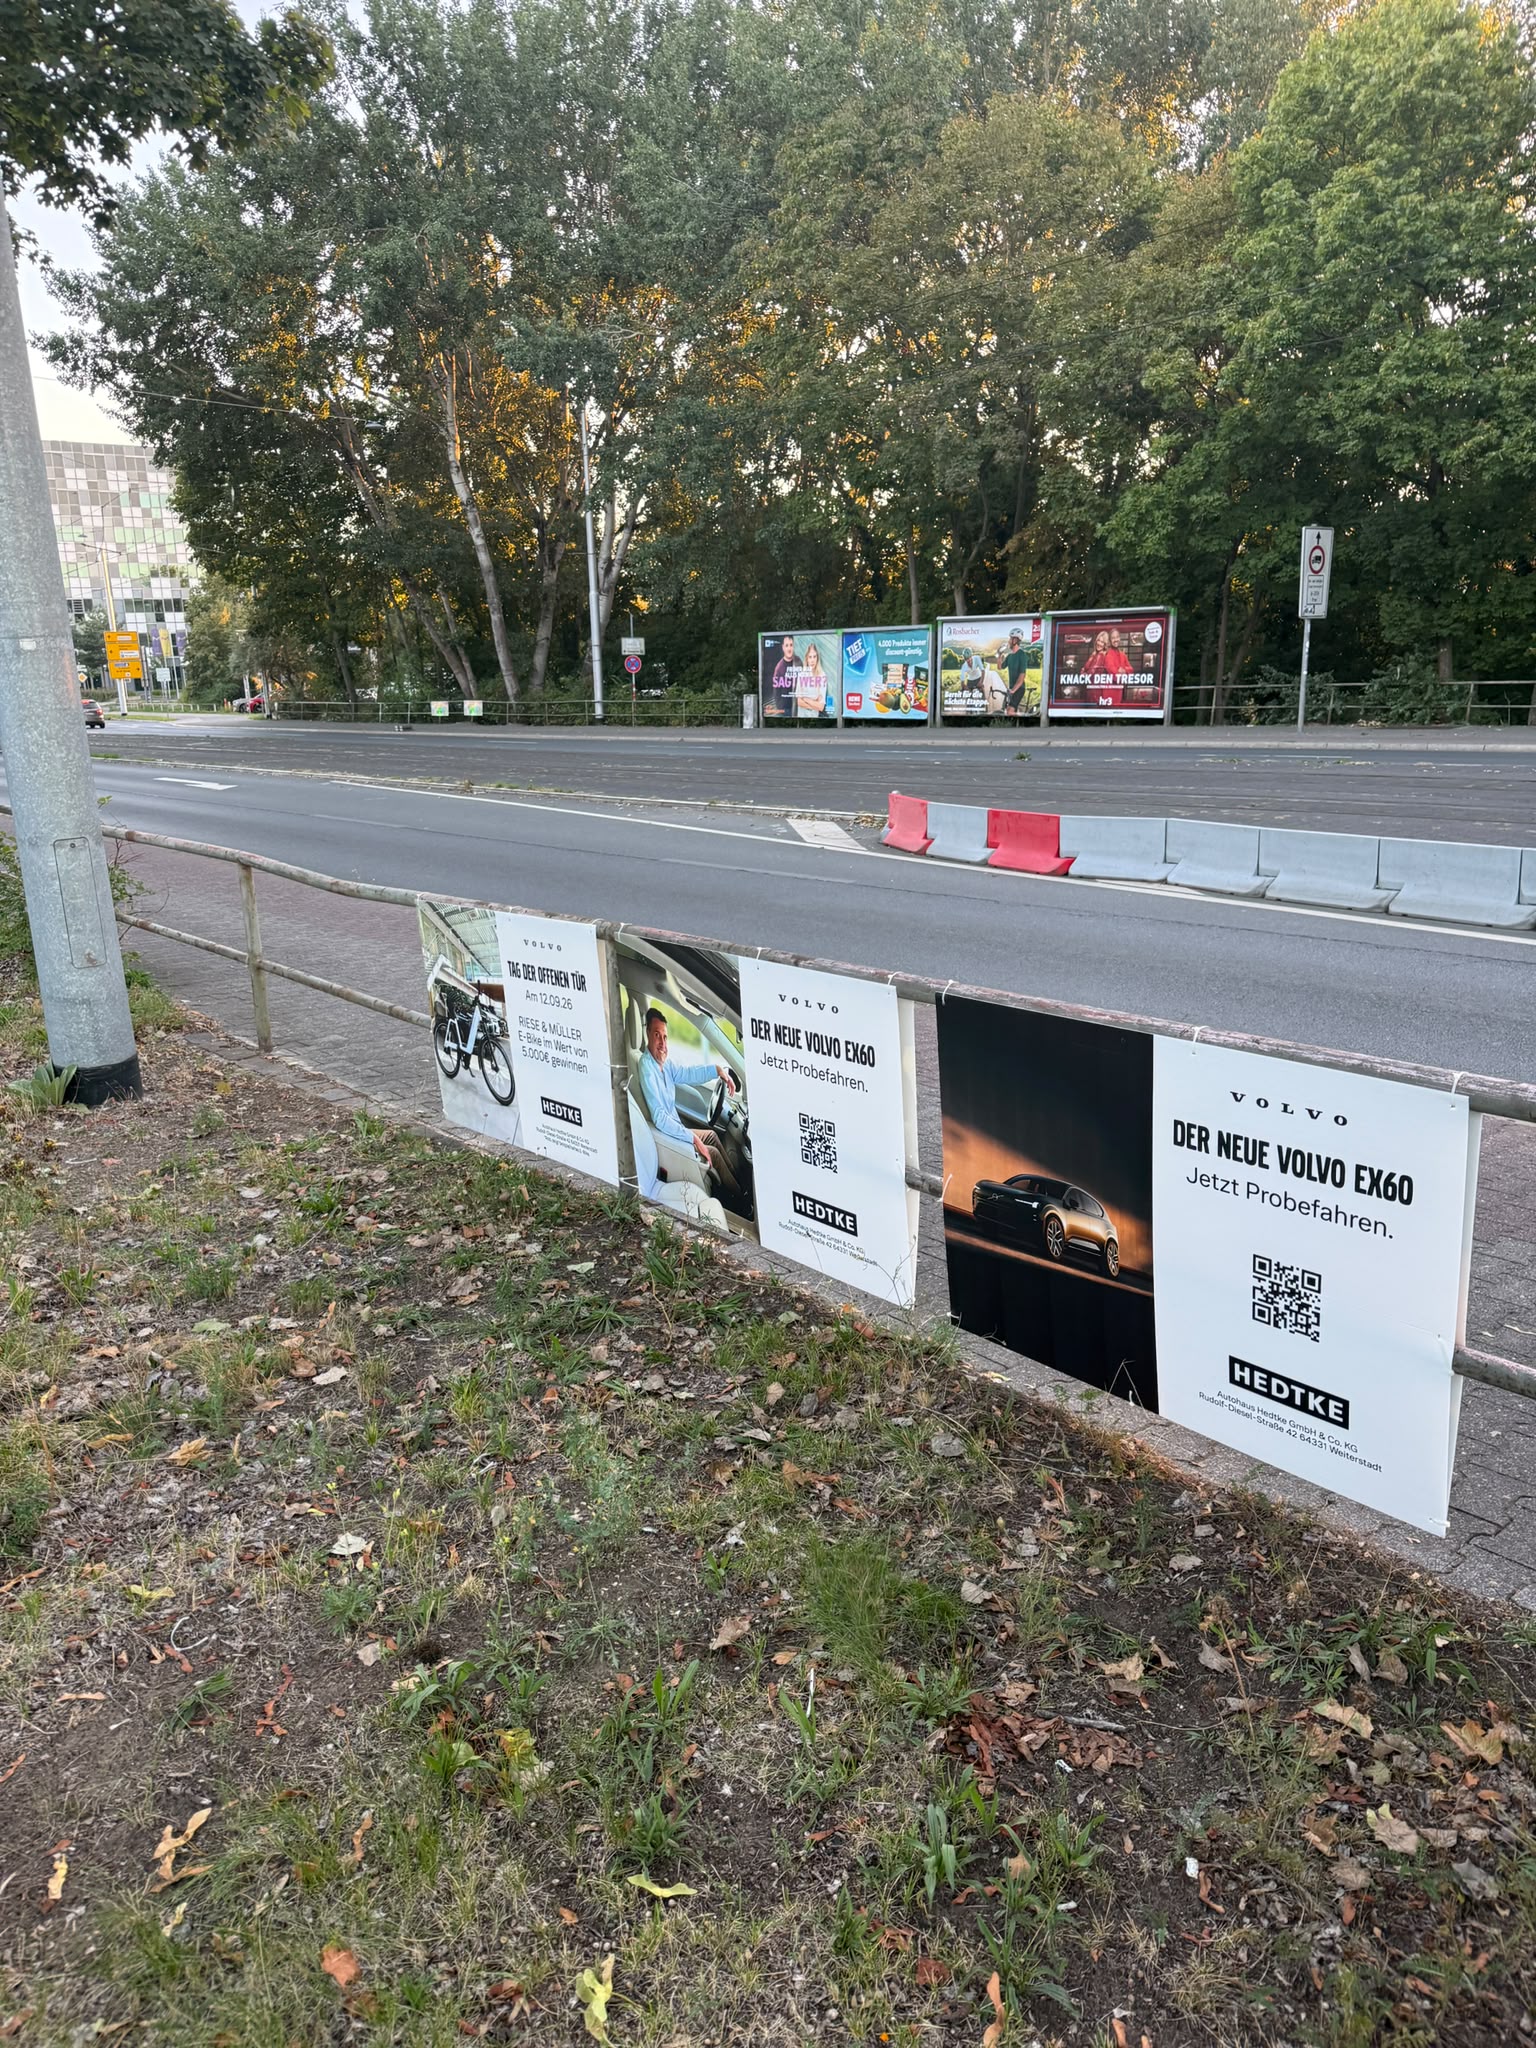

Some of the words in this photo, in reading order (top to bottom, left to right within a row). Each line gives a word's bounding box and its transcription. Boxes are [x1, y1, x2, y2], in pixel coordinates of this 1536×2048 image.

[846, 638, 862, 656] TIEF
[772, 676, 796, 688] SAGT
[800, 676, 827, 688] WER?
[1060, 674, 1092, 684] KNACK
[1094, 674, 1113, 684] DEN
[1115, 673, 1153, 684] TRESOR
[1099, 696, 1112, 705] hr3
[523, 939, 562, 951] VOLVO
[507, 961, 521, 979] TAG
[522, 963, 536, 982] DER
[538, 967, 570, 989] OFFENEN
[571, 971, 587, 992] TÜR
[525, 990, 538, 1002] Am
[540, 993, 573, 1010] 12.09.26
[778, 994, 839, 1014] VOLVO
[519, 1016, 540, 1031] RIESE
[542, 1021, 547, 1032] &
[549, 1022, 582, 1041] MÜLLER
[751, 1018, 771, 1041] DER
[774, 1023, 802, 1049] NEUE
[805, 1030, 841, 1059] VOLVO
[845, 1040, 875, 1067] EX60
[518, 1030, 542, 1046] E-Bike
[543, 1036, 553, 1049] im
[554, 1039, 572, 1055] Wert
[574, 1046, 588, 1058] von
[522, 1046, 550, 1063] 5.000€
[551, 1057, 588, 1074] gewinnen
[760, 1052, 788, 1071] Jetzt
[792, 1060, 869, 1093] Probefahren.
[542, 1099, 581, 1123] HEDTKE
[1230, 1091, 1348, 1126] VOLVO
[1173, 1119, 1210, 1154] DER
[1217, 1130, 1269, 1170] NEUE
[1277, 1145, 1345, 1188] VOLVO
[1354, 1164, 1413, 1206] EX60
[795, 1196, 855, 1232] HEDTKE
[1186, 1167, 1239, 1197] Jetzt
[1246, 1181, 1393, 1239] Probefahren.
[1234, 1363, 1344, 1422] HEDTKE
[1199, 1392, 1284, 1432] Rudolf-Diesel-Straße
[1286, 1428, 1298, 1438] 42
[1300, 1434, 1327, 1450] 64331
[1329, 1445, 1382, 1472] Weiterstadt
[1217, 1391, 1255, 1412] Autohaus
[1257, 1406, 1287, 1424] Hedtke
[1289, 1420, 1316, 1436] GmbH
[1319, 1432, 1325, 1440] &
[1327, 1435, 1342, 1447] Co.
[1344, 1441, 1358, 1453] KG
